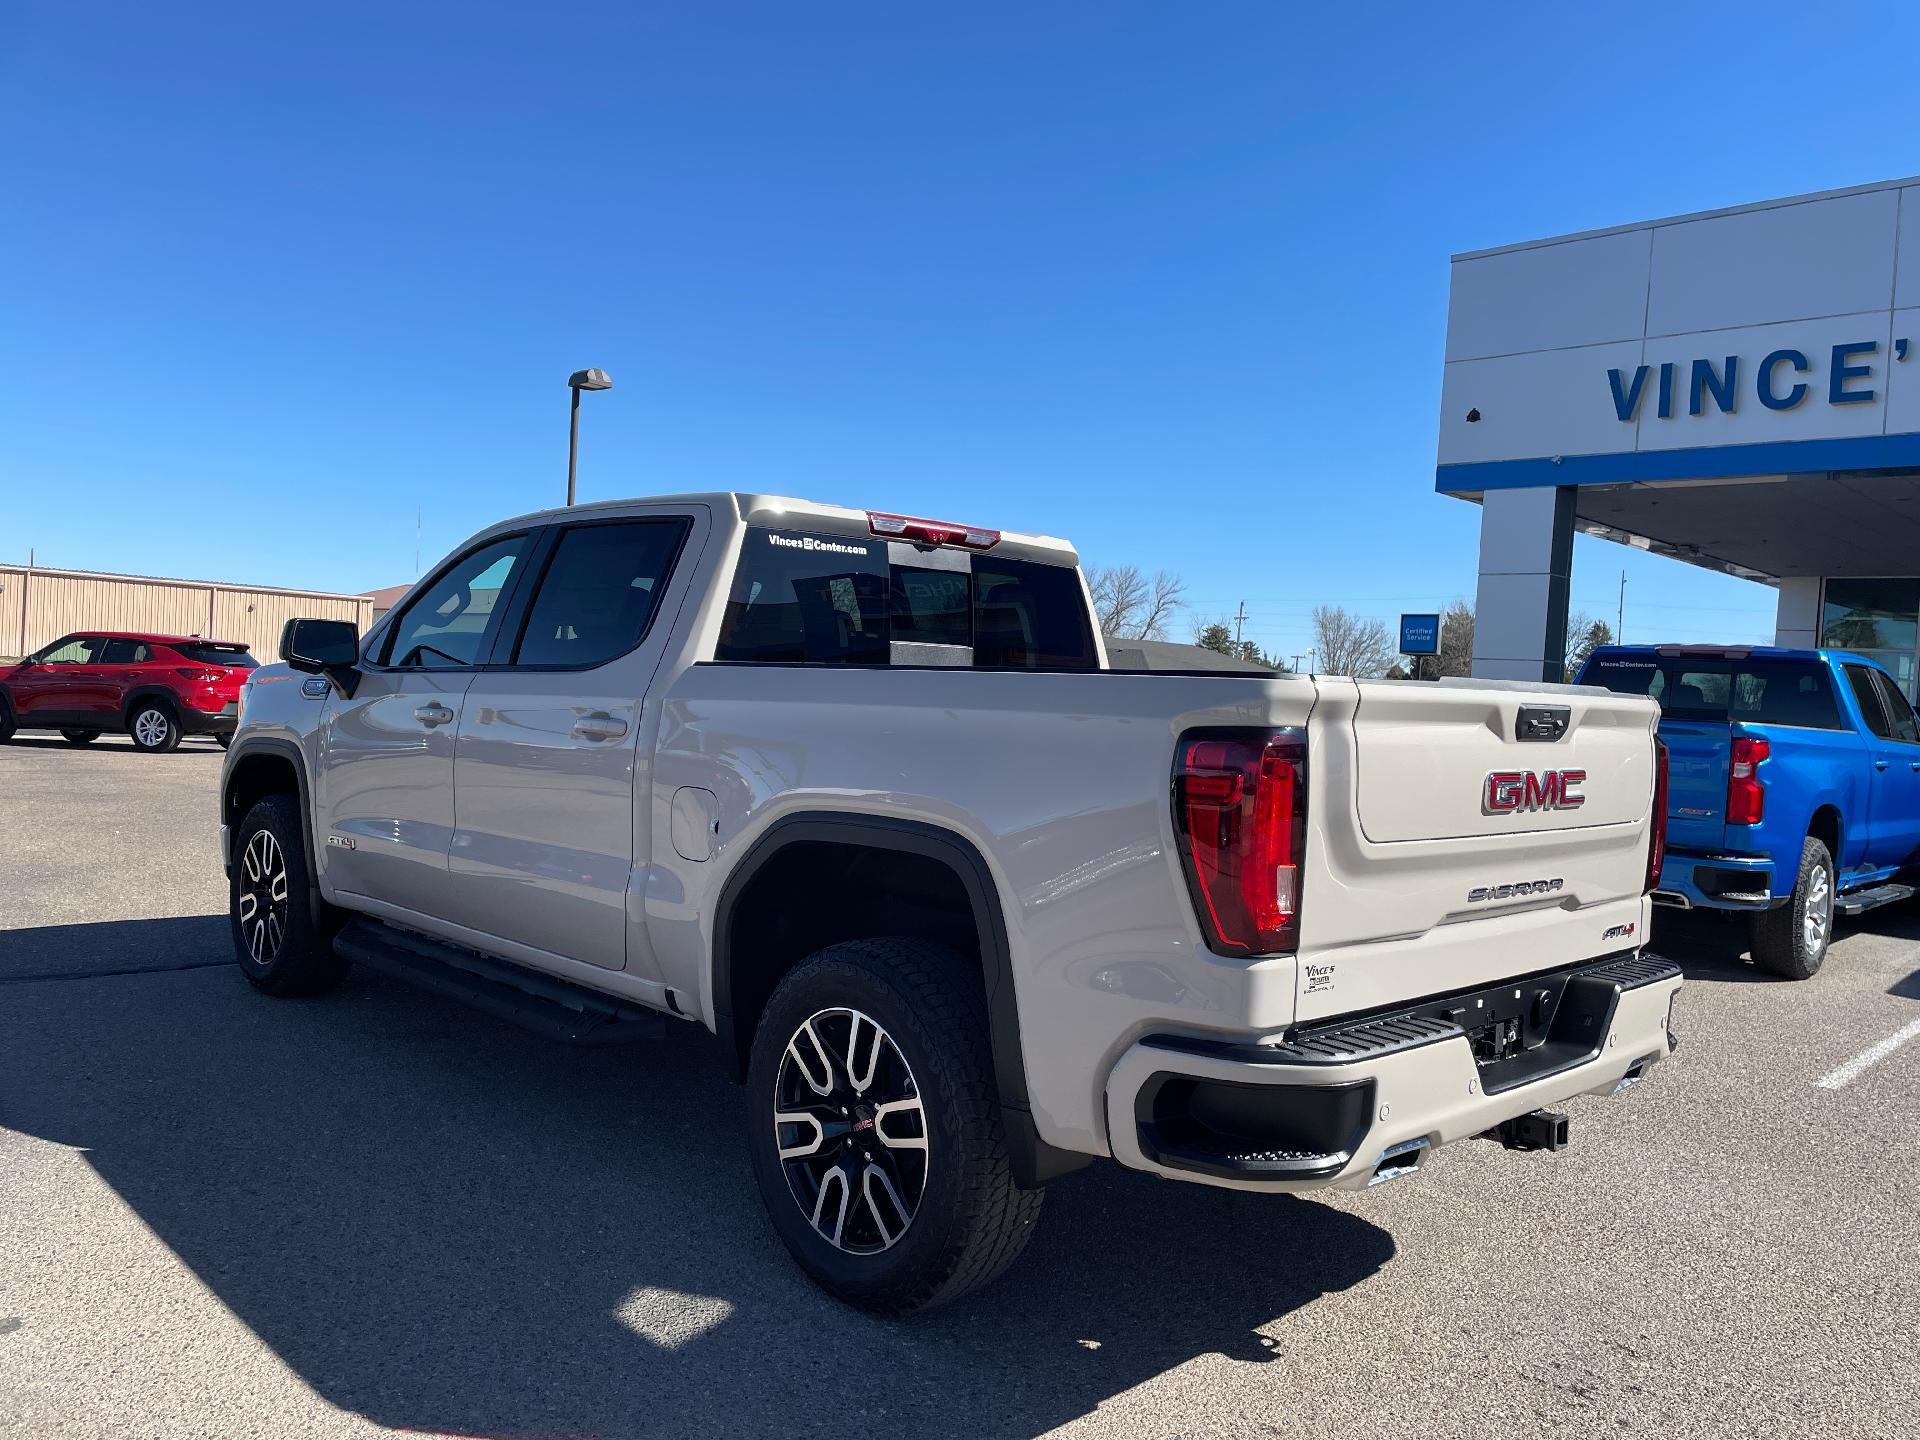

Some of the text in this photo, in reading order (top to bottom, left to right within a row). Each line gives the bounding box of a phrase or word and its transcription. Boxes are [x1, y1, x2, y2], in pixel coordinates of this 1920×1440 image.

[1405, 627, 1433, 635] Certified
[1481, 769, 1586, 816] GMC
[1467, 878, 1564, 903] SIERRA
[1601, 922, 1635, 941] AT4
